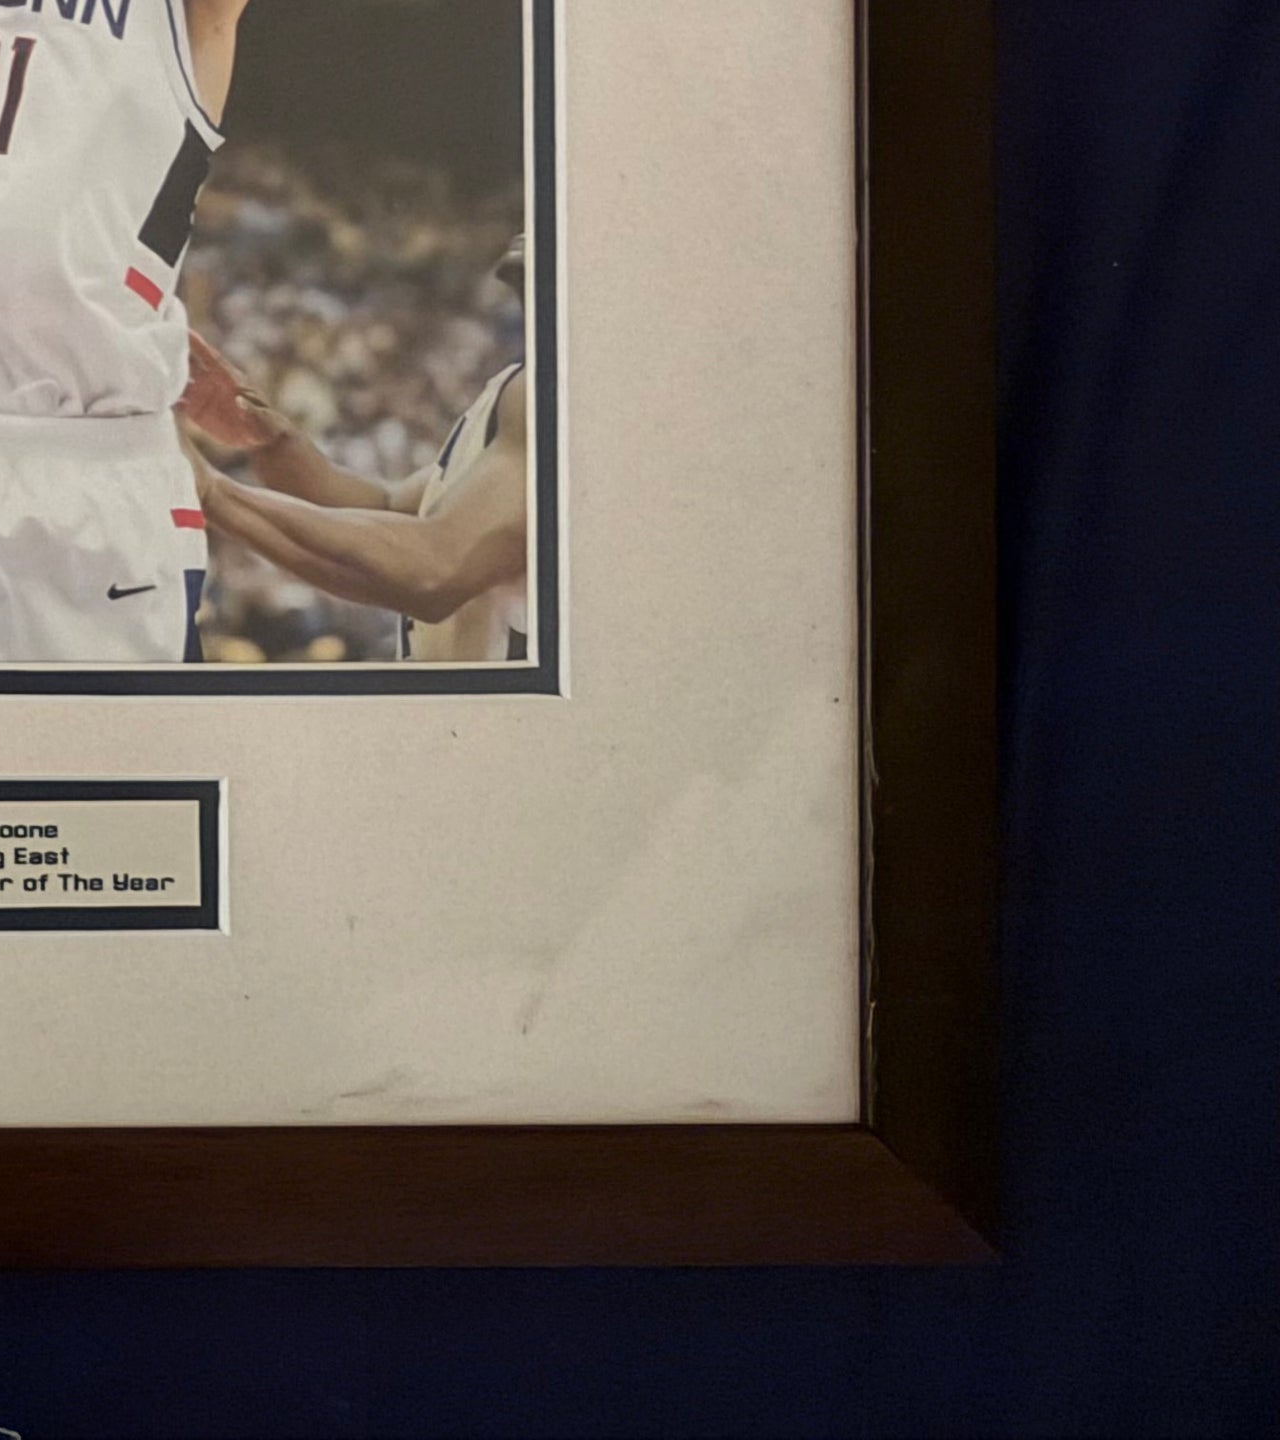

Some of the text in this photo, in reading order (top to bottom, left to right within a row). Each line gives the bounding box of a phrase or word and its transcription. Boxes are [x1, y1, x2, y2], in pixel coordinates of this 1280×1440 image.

[13, 846, 70, 866] East
[22, 873, 49, 893] of
[56, 873, 104, 893] The
[112, 872, 176, 893] Year
